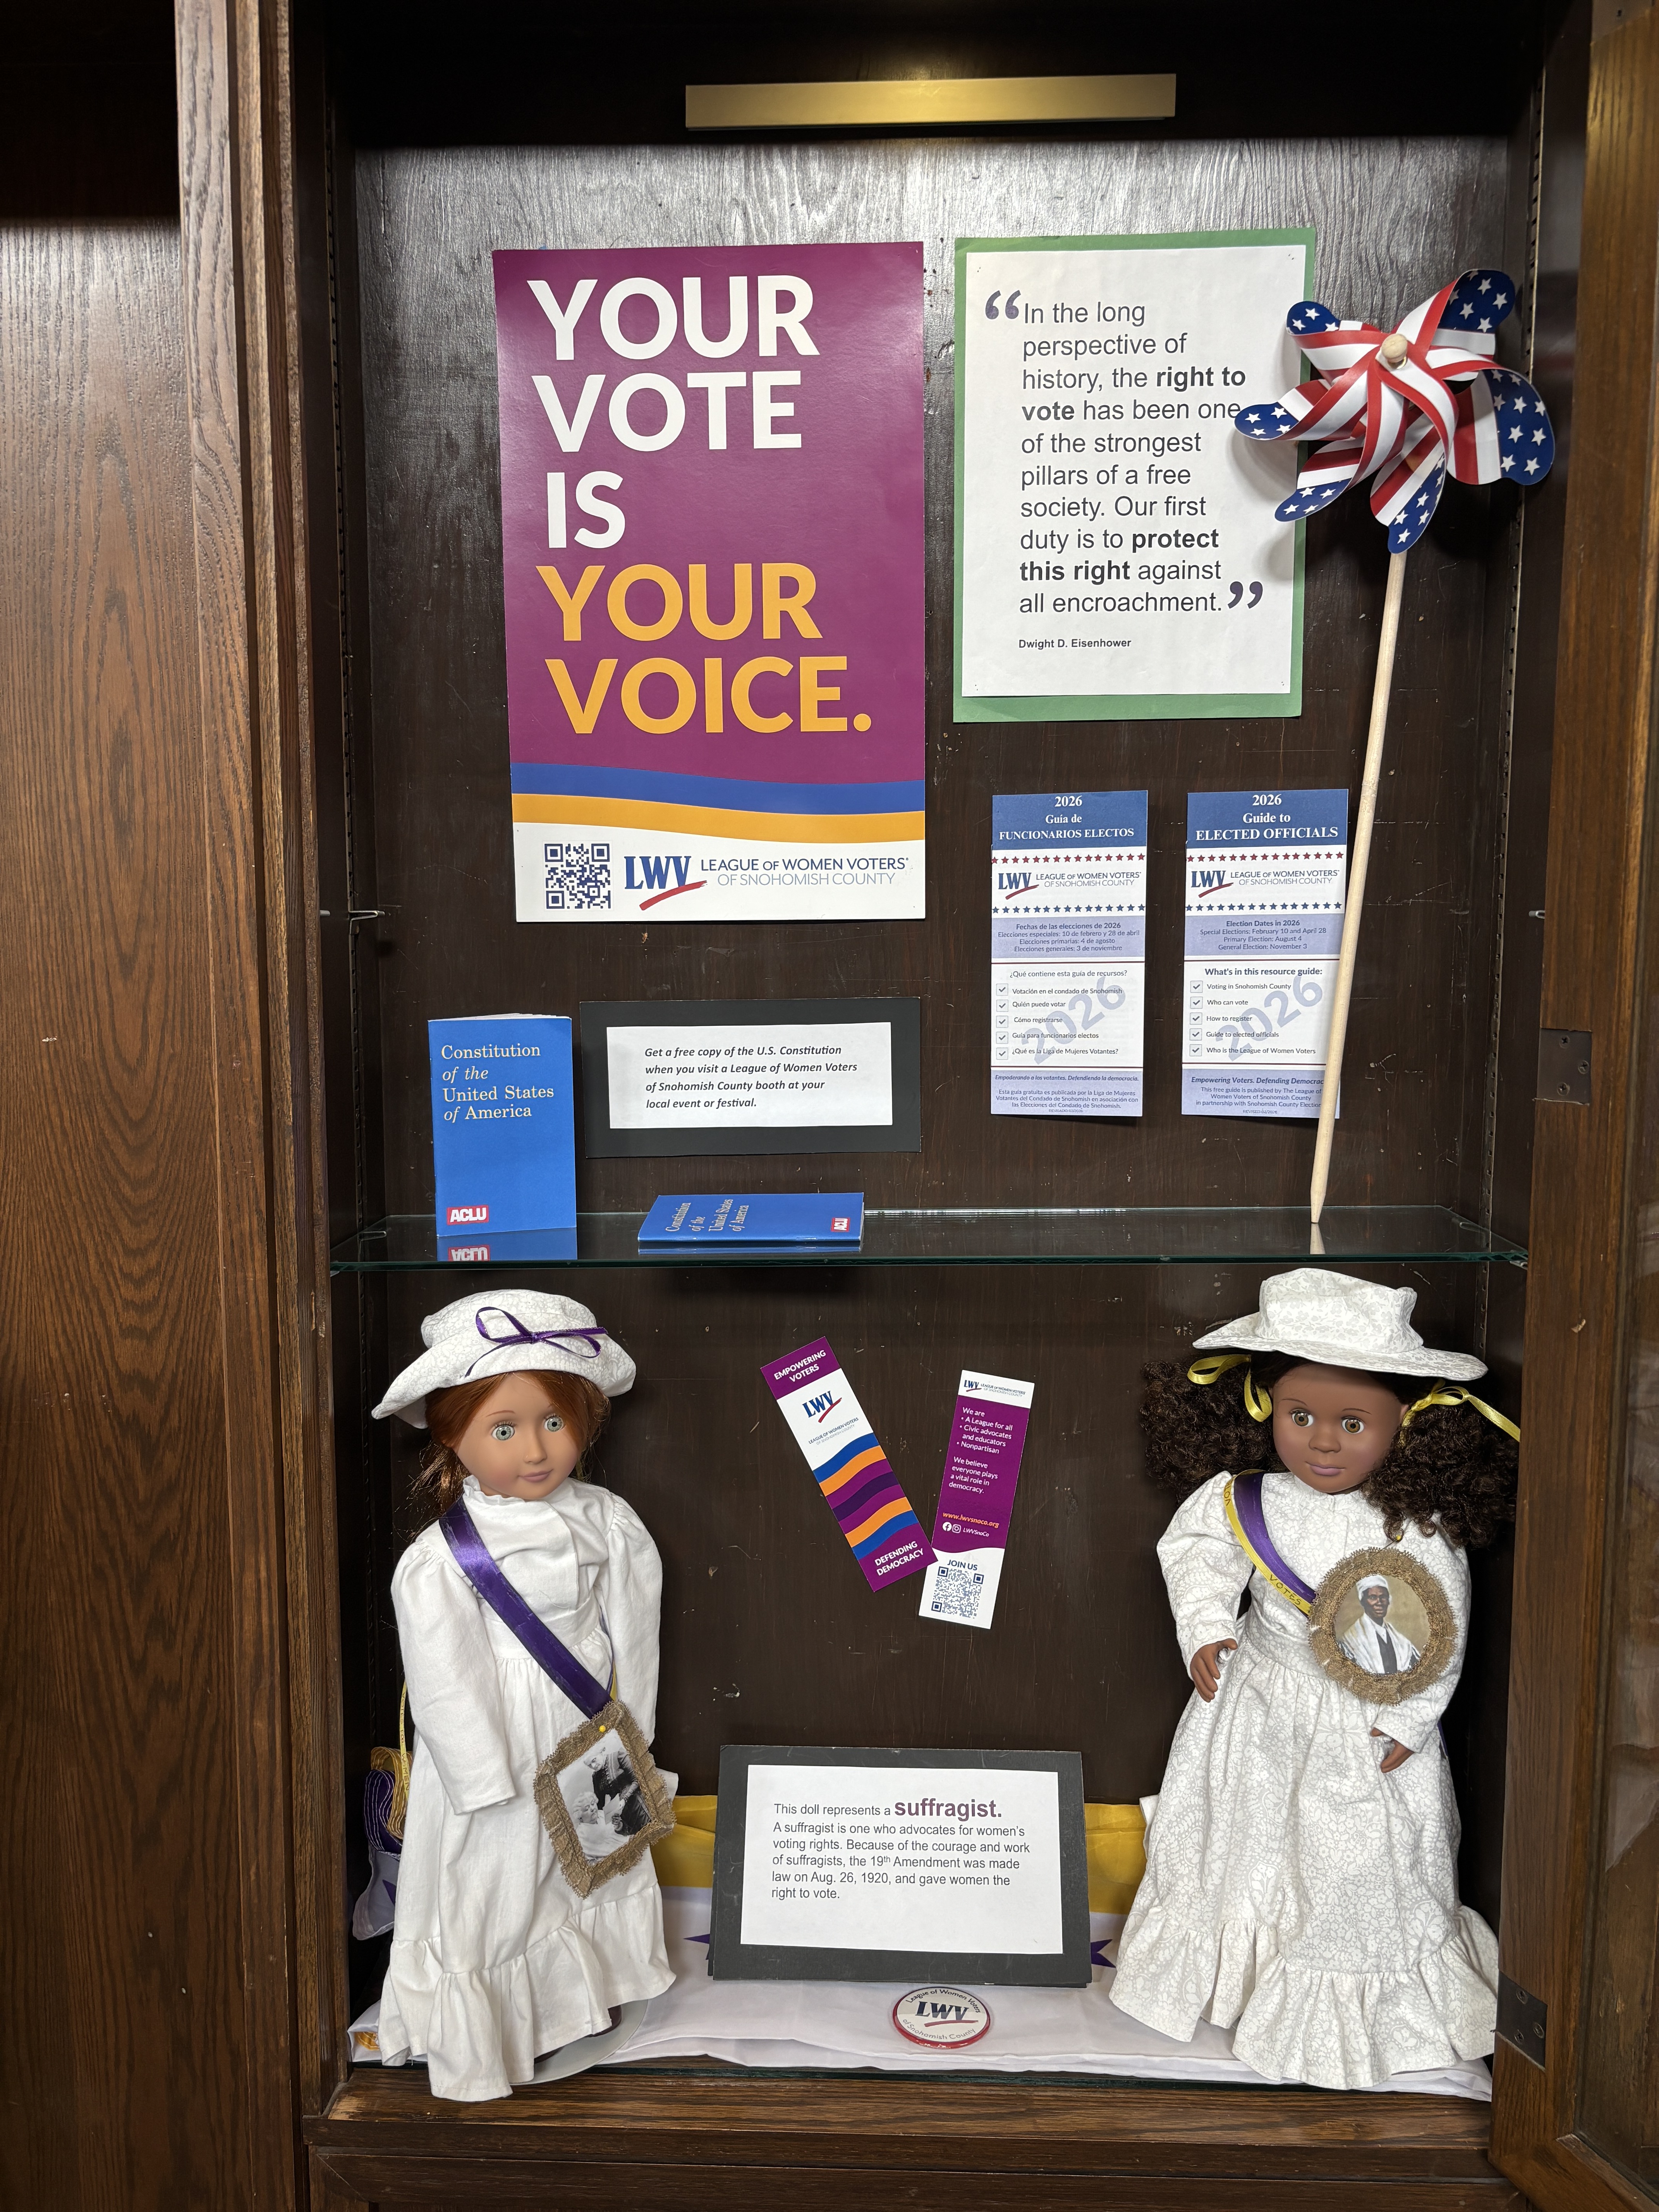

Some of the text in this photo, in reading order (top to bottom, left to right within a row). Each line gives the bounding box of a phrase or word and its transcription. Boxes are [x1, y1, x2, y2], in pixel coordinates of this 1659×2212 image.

[527, 275, 820, 360] YOUR
[1053, 303, 1088, 323] the
[1098, 302, 1144, 326] long
[1024, 333, 1187, 361] perspective of
[1024, 366, 1245, 393] history, the right to
[531, 371, 801, 452] VOTE
[1022, 400, 1240, 420] vote has been one
[1022, 433, 1201, 457] of the strongest
[1022, 464, 1190, 491] pillars of a free
[547, 471, 625, 550] IS
[1021, 496, 1206, 521] society. Our first
[1021, 529, 1219, 554] duty is to protect
[1020, 560, 1221, 585] this right against
[536, 563, 823, 641] YOUR
[1020, 593, 1043, 613] all
[1019, 639, 1054, 649] Dwight
[1072, 639, 1131, 647] Eisenhower
[545, 656, 871, 734] VOICE.
[1055, 796, 1082, 807] 2026
[1253, 794, 1281, 805] 2026
[1046, 814, 1082, 823] Guía de
[1243, 813, 1290, 823] Guide to
[1000, 829, 1134, 840] FUNCIONARIOS ELECTOS
[1196, 827, 1338, 840] ELECTED OFFICIALS
[702, 859, 759, 871] LEAGUE
[782, 859, 842, 870] WOMEN
[718, 873, 895, 885] OF SNOHOMISH COUNTY
[1298, 968, 1322, 976] guide:
[441, 1043, 540, 1059] Constitution
[674, 1048, 694, 1058] free
[698, 1049, 721, 1058] copy
[725, 1047, 735, 1057] of
[738, 1047, 754, 1055] the
[757, 1047, 776, 1055] U.S.
[780, 1046, 841, 1054] Constitution
[443, 1066, 488, 1083] of the
[443, 1086, 553, 1101] United States
[646, 1099, 670, 1108] local
[716, 1098, 756, 1109] festival.
[444, 1104, 532, 1123] of America
[450, 1207, 487, 1223] ACLU
[774, 1350, 826, 1379] EMPOWERING
[789, 1364, 819, 1382] VOTERS
[972, 1418, 993, 1427] League
[975, 1437, 1006, 1446] educators
[981, 1429, 1012, 1439] advocates
[961, 1441, 999, 1453] Nonpartisan
[875, 1541, 917, 1566] DEFENDING
[877, 1548, 923, 1575] DEMOCRACY
[948, 1560, 965, 1568] JOIN
[1270, 1574, 1302, 1606] VOTES
[774, 1804, 797, 1814] This
[801, 1804, 819, 1814] doll
[824, 1806, 880, 1817] represents
[895, 1798, 1001, 1821] suffragist.
[773, 1822, 781, 1832] A
[785, 1822, 834, 1835] suffragist
[838, 1823, 846, 1833] is
[874, 1824, 895, 1834] who
[900, 1824, 955, 1834] advocates
[959, 1825, 973, 1835] for
[772, 1887, 839, 1900] right to vote.
[906, 1992, 929, 2003] League
[940, 1989, 967, 2000] Women
[968, 1998, 981, 2013] Voters
[915, 2001, 969, 2020] LWV
[907, 2024, 947, 2040] Snohomish
[949, 2028, 976, 2039] County
